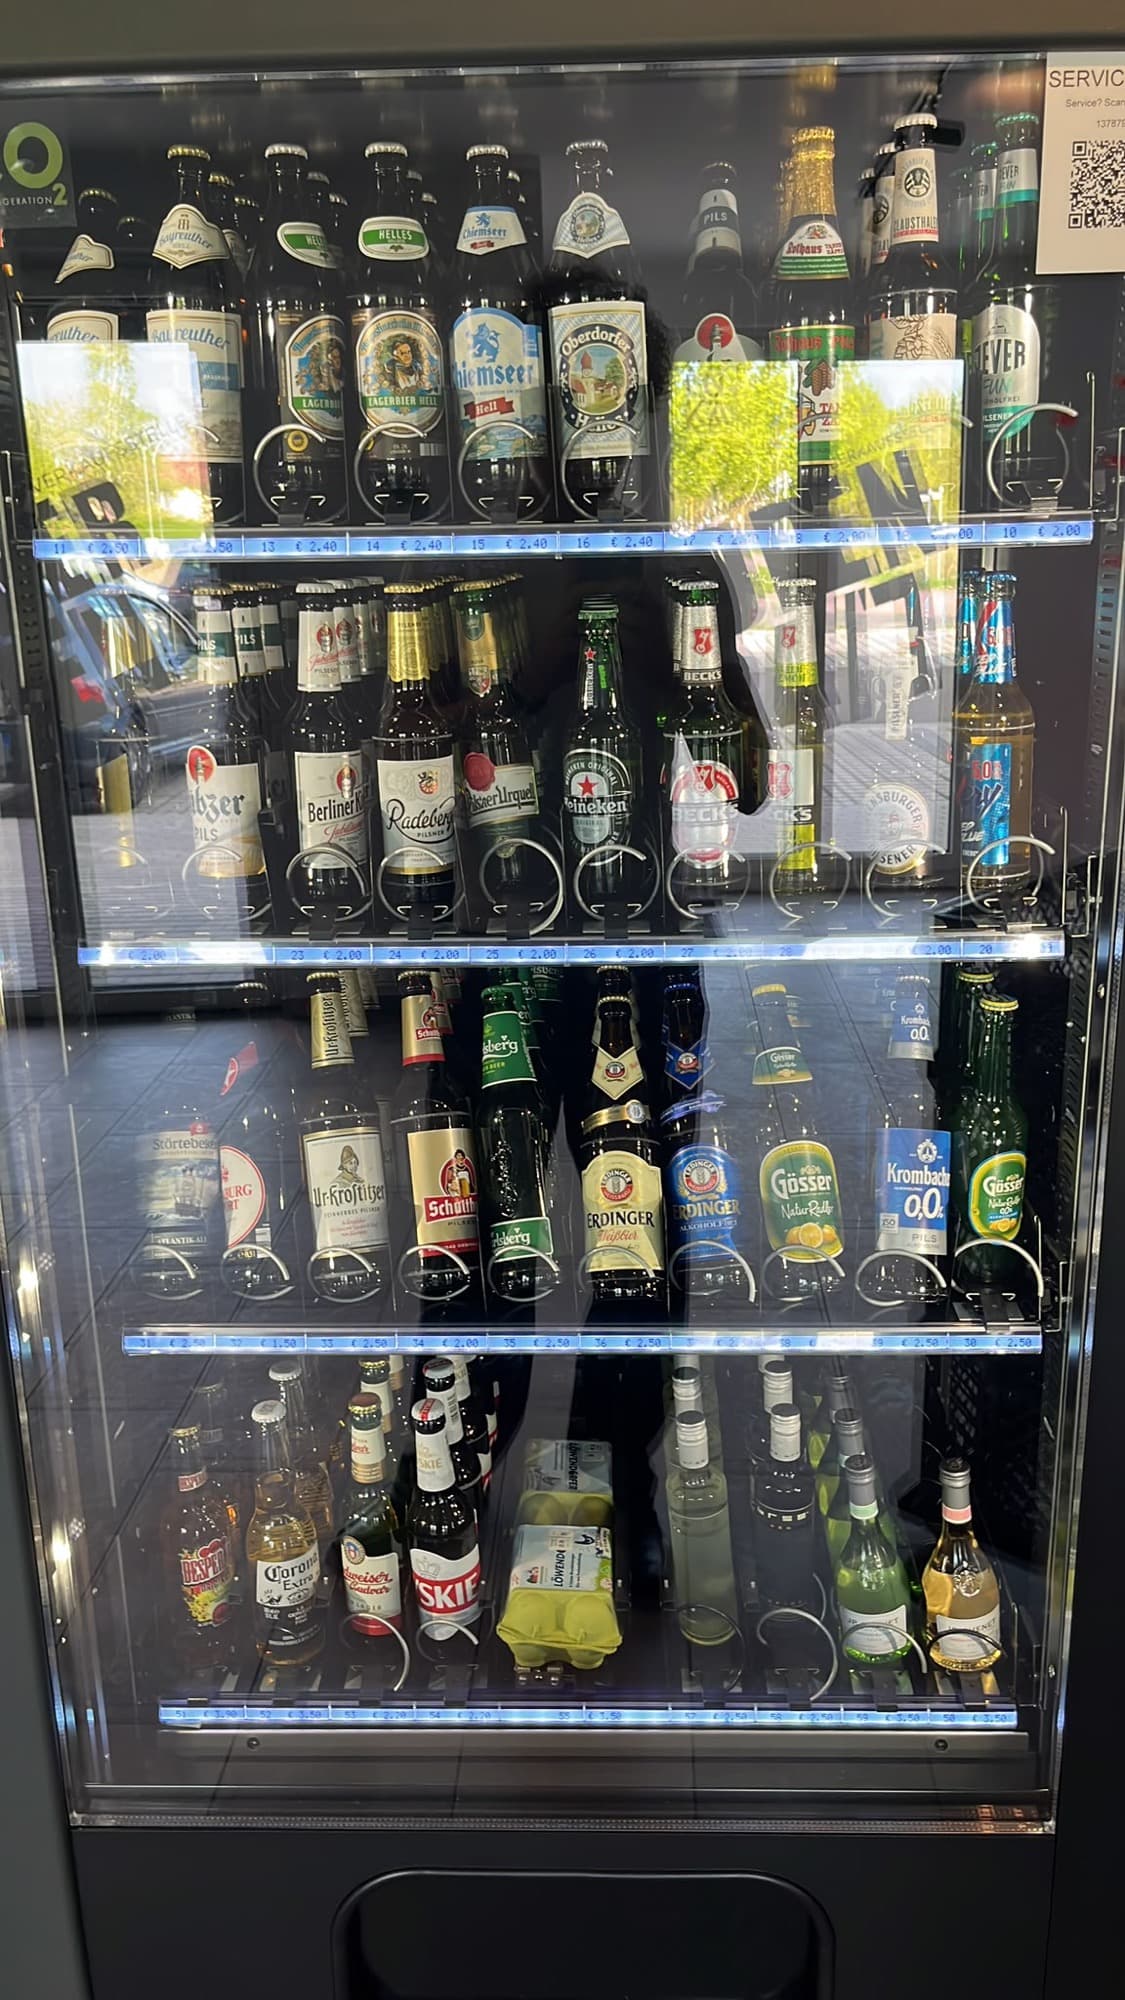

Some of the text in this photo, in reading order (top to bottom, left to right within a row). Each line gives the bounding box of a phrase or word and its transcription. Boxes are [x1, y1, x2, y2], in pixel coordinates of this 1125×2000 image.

[1049, 69, 1125, 88] SERVIC
[1066, 98, 1102, 108] Service?
[703, 212, 728, 225] PILS
[379, 229, 412, 241] HELLES
[151, 326, 231, 350] Bayreuther
[562, 326, 631, 357] Oberdorfer
[368, 395, 416, 407] LAGERBIER
[475, 401, 498, 416] Hell
[944, 528, 973, 539] 00
[1003, 525, 1081, 538] 10 € 2.00
[577, 536, 653, 548] 16 € 2.40
[717, 535, 724, 545] €
[791, 533, 802, 543] 8
[824, 532, 831, 542] €
[54, 543, 128, 553] 11 € 2.50
[262, 541, 337, 552] 13 € 2.40
[367, 540, 442, 551] 14 € 2.40
[471, 538, 548, 550] 15 € 2.40
[587, 761, 619, 786] ORIGINAL
[308, 796, 356, 823] Berliner
[486, 949, 556, 959] 25 € 2.00
[583, 948, 654, 958] 26 € 2.00
[680, 948, 694, 957] 27
[926, 945, 952, 955] 2.00
[979, 944, 993, 954] 20
[291, 950, 362, 960] 23 € 2.00
[389, 950, 459, 960] 24 € 2.00
[771, 1168, 832, 1200] Gösser
[982, 1175, 1024, 1197] Gösser
[672, 1199, 742, 1221] ERDINGER
[587, 1210, 656, 1229] ERDINGER
[911, 1232, 937, 1243] PILS
[139, 1339, 151, 1348] 31
[170, 1338, 175, 1347] €
[261, 1338, 266, 1348] €
[272, 1338, 296, 1348] 1.50
[320, 1338, 387, 1348] 33 € 2.50
[413, 1338, 478, 1347] 34 € 2.00
[504, 1338, 570, 1348] 35 € 2.50
[595, 1338, 661, 1347] 36 € 2.50
[688, 1338, 722, 1347] 3 €
[809, 1338, 816, 1347] €
[902, 1337, 939, 1347] € 2.50
[965, 1337, 1032, 1347] 30 € 2.50
[264, 1553, 318, 1583] Corona
[283, 1574, 314, 1592] Extra
